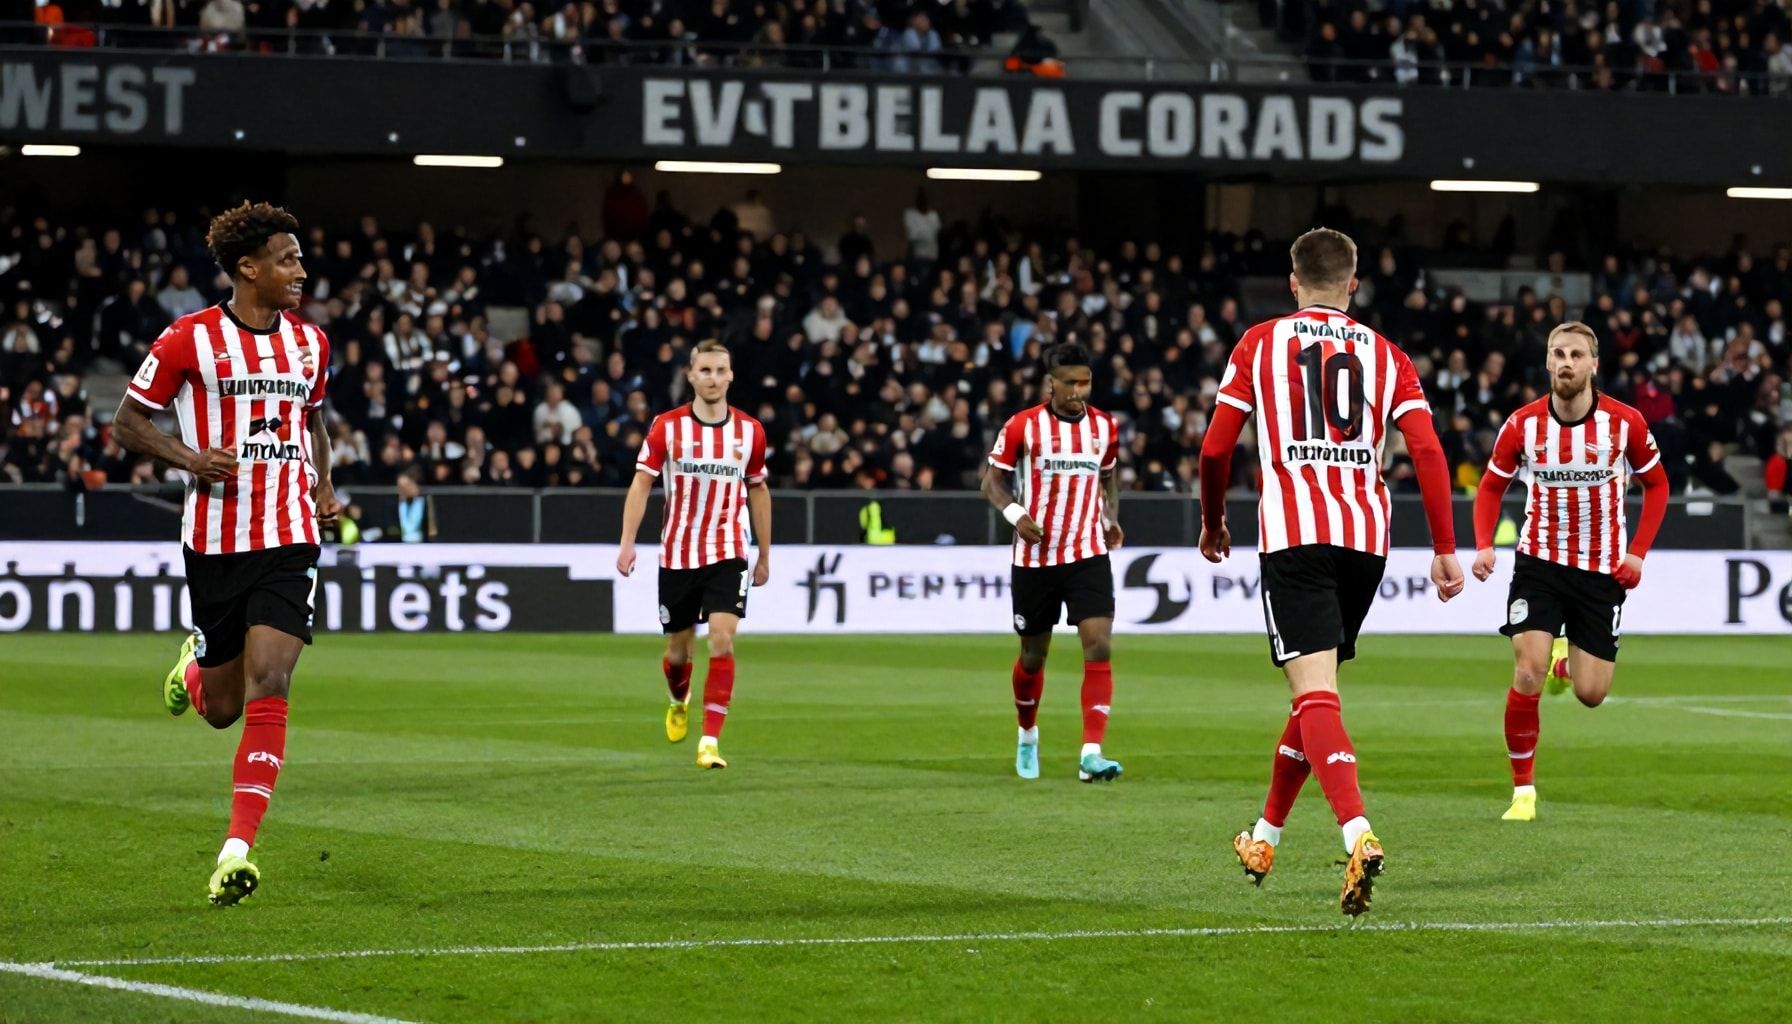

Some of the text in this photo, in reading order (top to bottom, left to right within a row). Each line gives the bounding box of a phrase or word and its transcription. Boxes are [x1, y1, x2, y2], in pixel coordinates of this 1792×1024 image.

[0, 63, 196, 135] WEST
[1098, 90, 1404, 162] CORADS
[1295, 341, 1365, 442] 10
[869, 573, 1012, 600] PERTH
